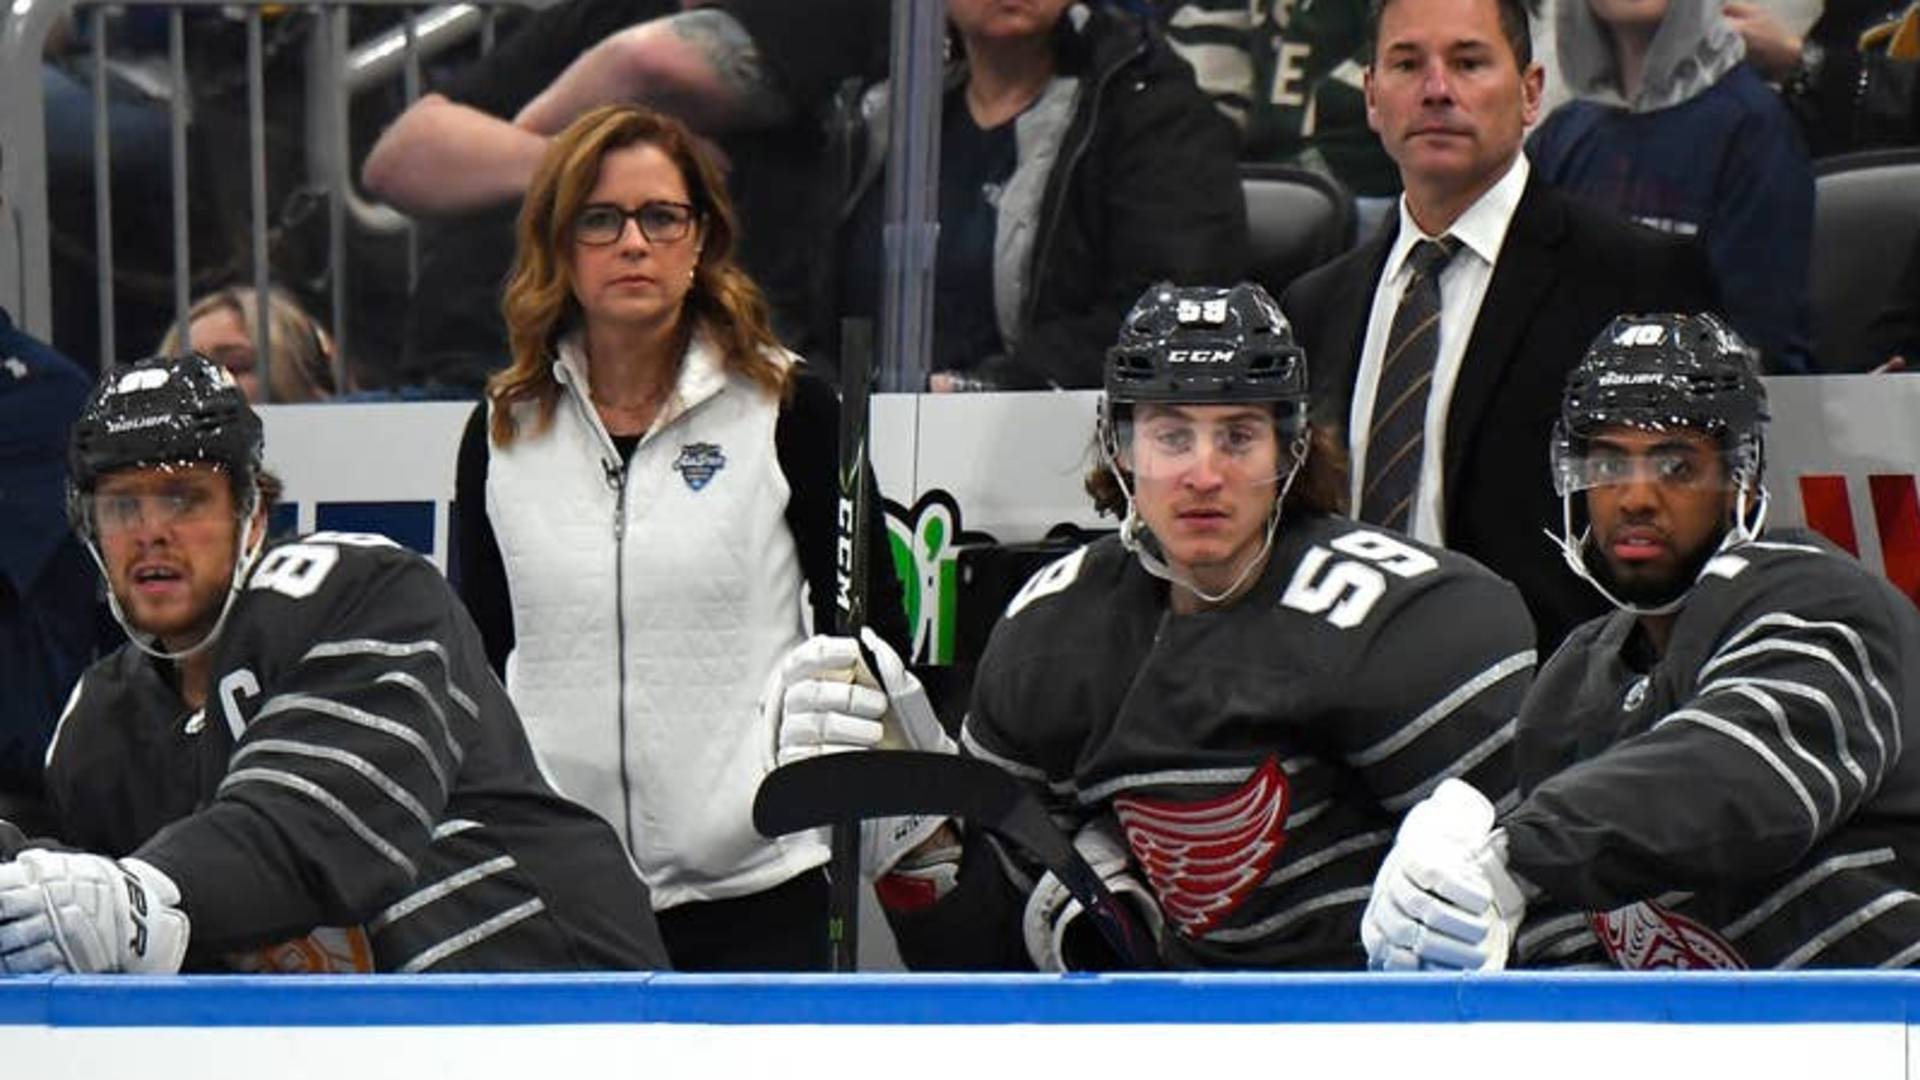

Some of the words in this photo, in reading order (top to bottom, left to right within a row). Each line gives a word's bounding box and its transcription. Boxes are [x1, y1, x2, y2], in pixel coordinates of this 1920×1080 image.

[1167, 351, 1236, 363] CCM
[836, 498, 853, 612] CCM
[1280, 529, 1439, 629] 59
